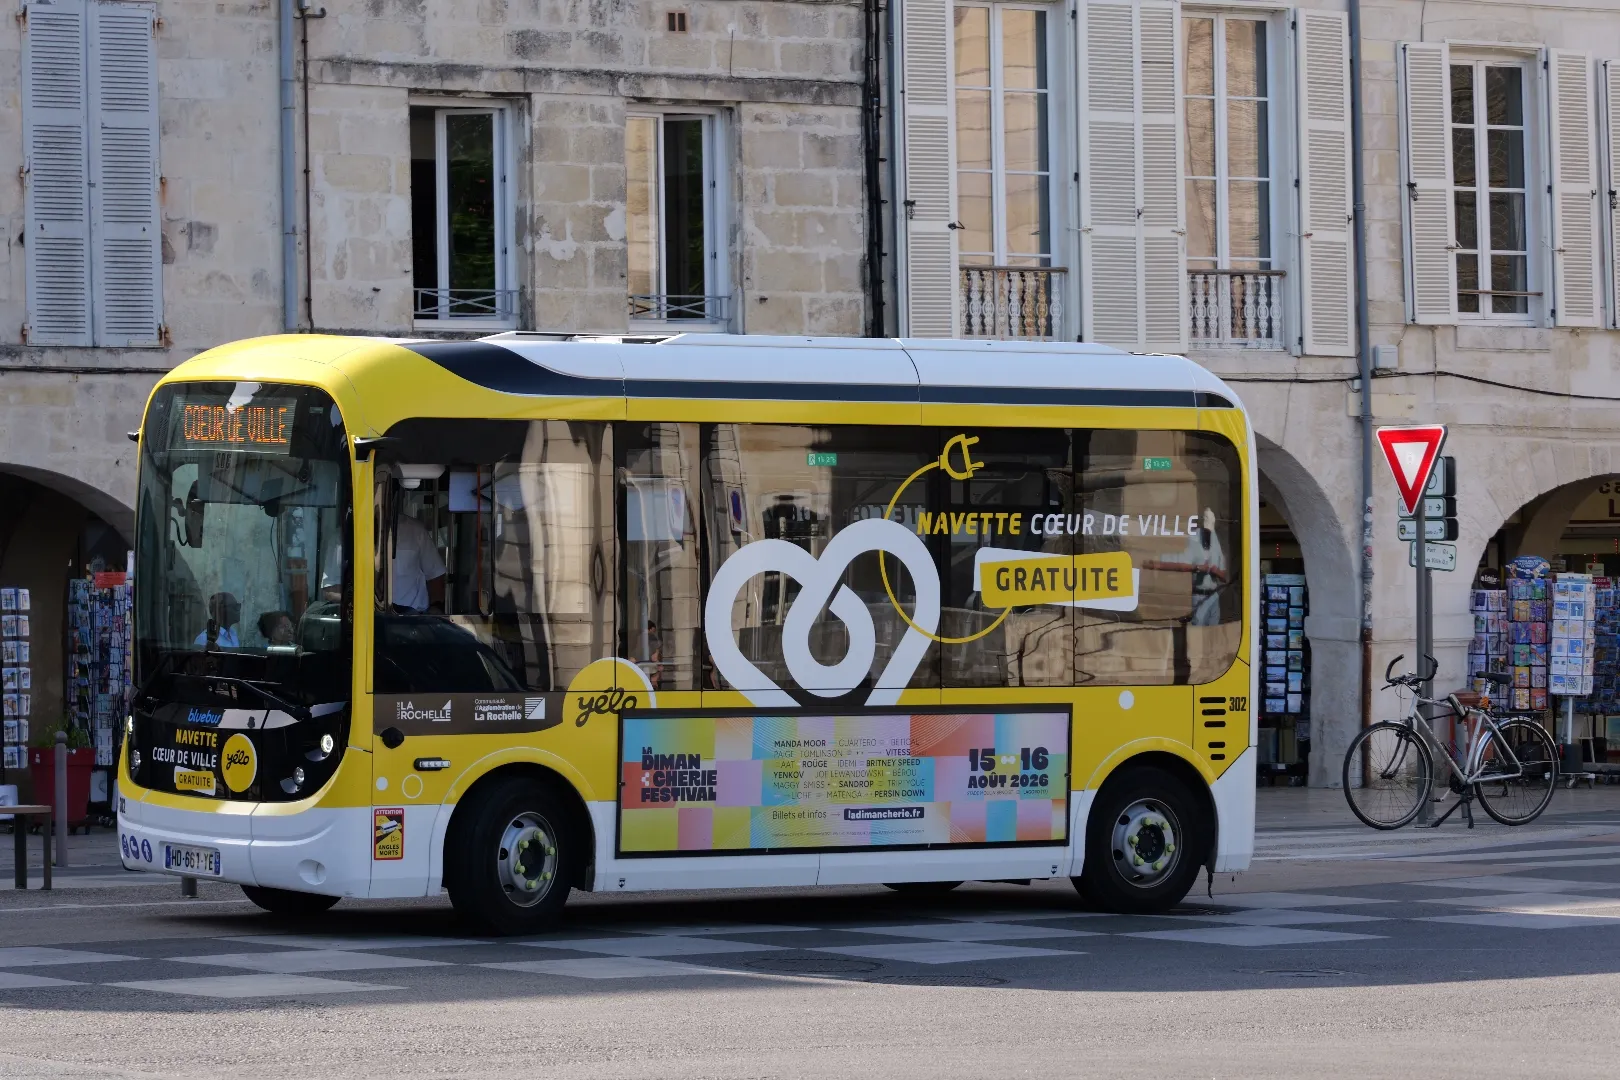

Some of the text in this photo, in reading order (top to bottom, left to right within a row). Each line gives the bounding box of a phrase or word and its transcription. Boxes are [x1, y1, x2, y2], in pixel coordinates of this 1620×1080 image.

[184, 405, 287, 443] COEUR DE VILLE
[917, 512, 1022, 535] NAVETTE
[1030, 513, 1094, 535] CŒUR
[1103, 513, 1129, 535] DE
[1139, 514, 1198, 536] VILLE
[996, 567, 1119, 591] GRATUITE
[401, 701, 414, 710] LA
[575, 686, 637, 727] yélo
[1228, 696, 1247, 712] 302
[188, 708, 222, 725] bluebus
[400, 709, 451, 720] ROCHELLE
[474, 711, 523, 721] La Rochelle
[175, 728, 218, 748] NAVETTE
[774, 740, 801, 748] MANDA
[152, 746, 217, 769] CŒUR DE VILLE
[642, 747, 652, 755] LA
[969, 747, 1049, 771] 15 16
[226, 749, 250, 771] yélo
[641, 754, 701, 770] DIMAN
[802, 759, 828, 768] ROÜGE
[866, 759, 896, 767] BRITNEY
[897, 758, 921, 766] SPEED
[178, 773, 211, 788] GRATUITE
[653, 770, 718, 787] CHERIE
[773, 771, 804, 779] YENKOV
[968, 772, 1049, 788] AOÛT 2026
[838, 780, 874, 788] SANDROP
[641, 786, 717, 803] FESTIVAL
[874, 790, 901, 798] PERSIN
[901, 789, 925, 797] DOWN
[772, 808, 921, 820] Billets et infos ladimancherie.fr
